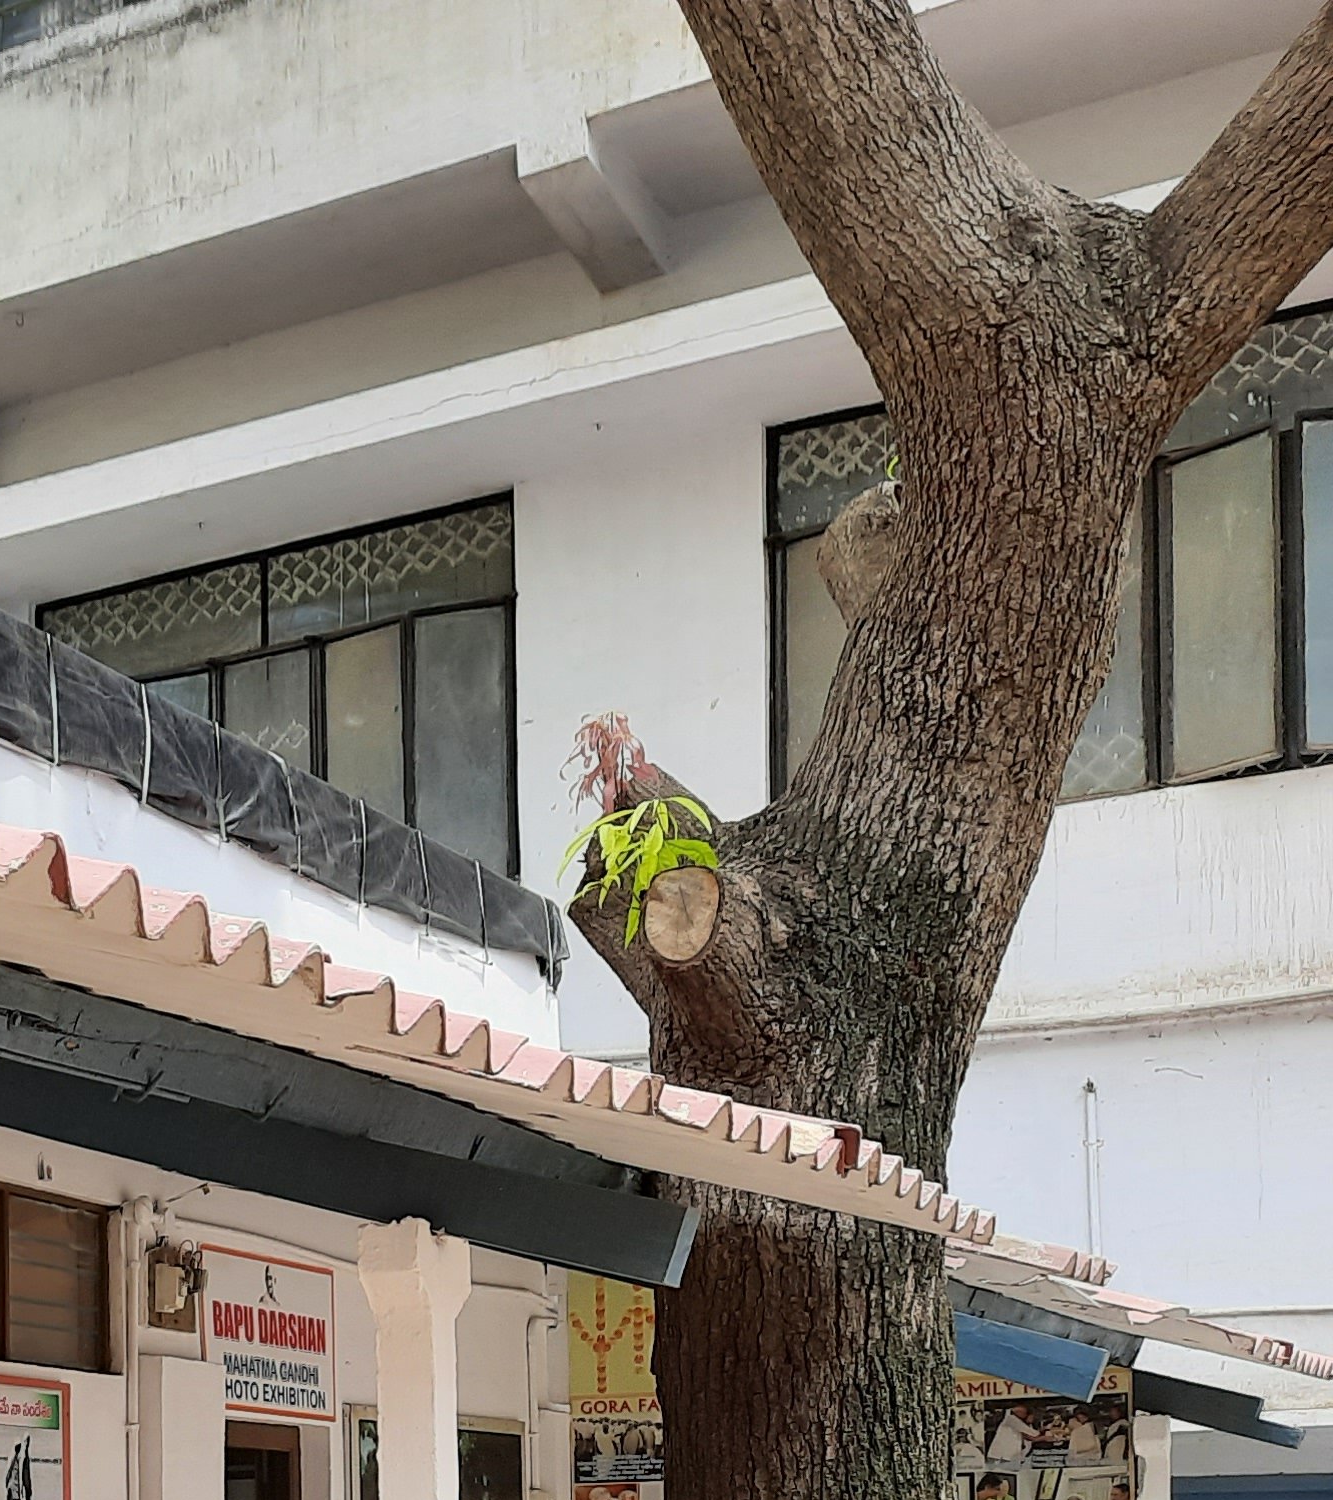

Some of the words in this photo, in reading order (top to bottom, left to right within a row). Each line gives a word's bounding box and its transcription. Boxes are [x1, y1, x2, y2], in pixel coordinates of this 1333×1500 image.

[212, 1300, 254, 1343] BAPU
[258, 1308, 326, 1355] DARSHAN
[223, 1352, 278, 1381] MAHATMA
[279, 1361, 319, 1387] GANDHI
[225, 1378, 259, 1401] HOTO
[263, 1384, 325, 1409] EXHIBITION
[955, 1381, 1014, 1397] AMILY
[580, 1400, 631, 1414] GORA
